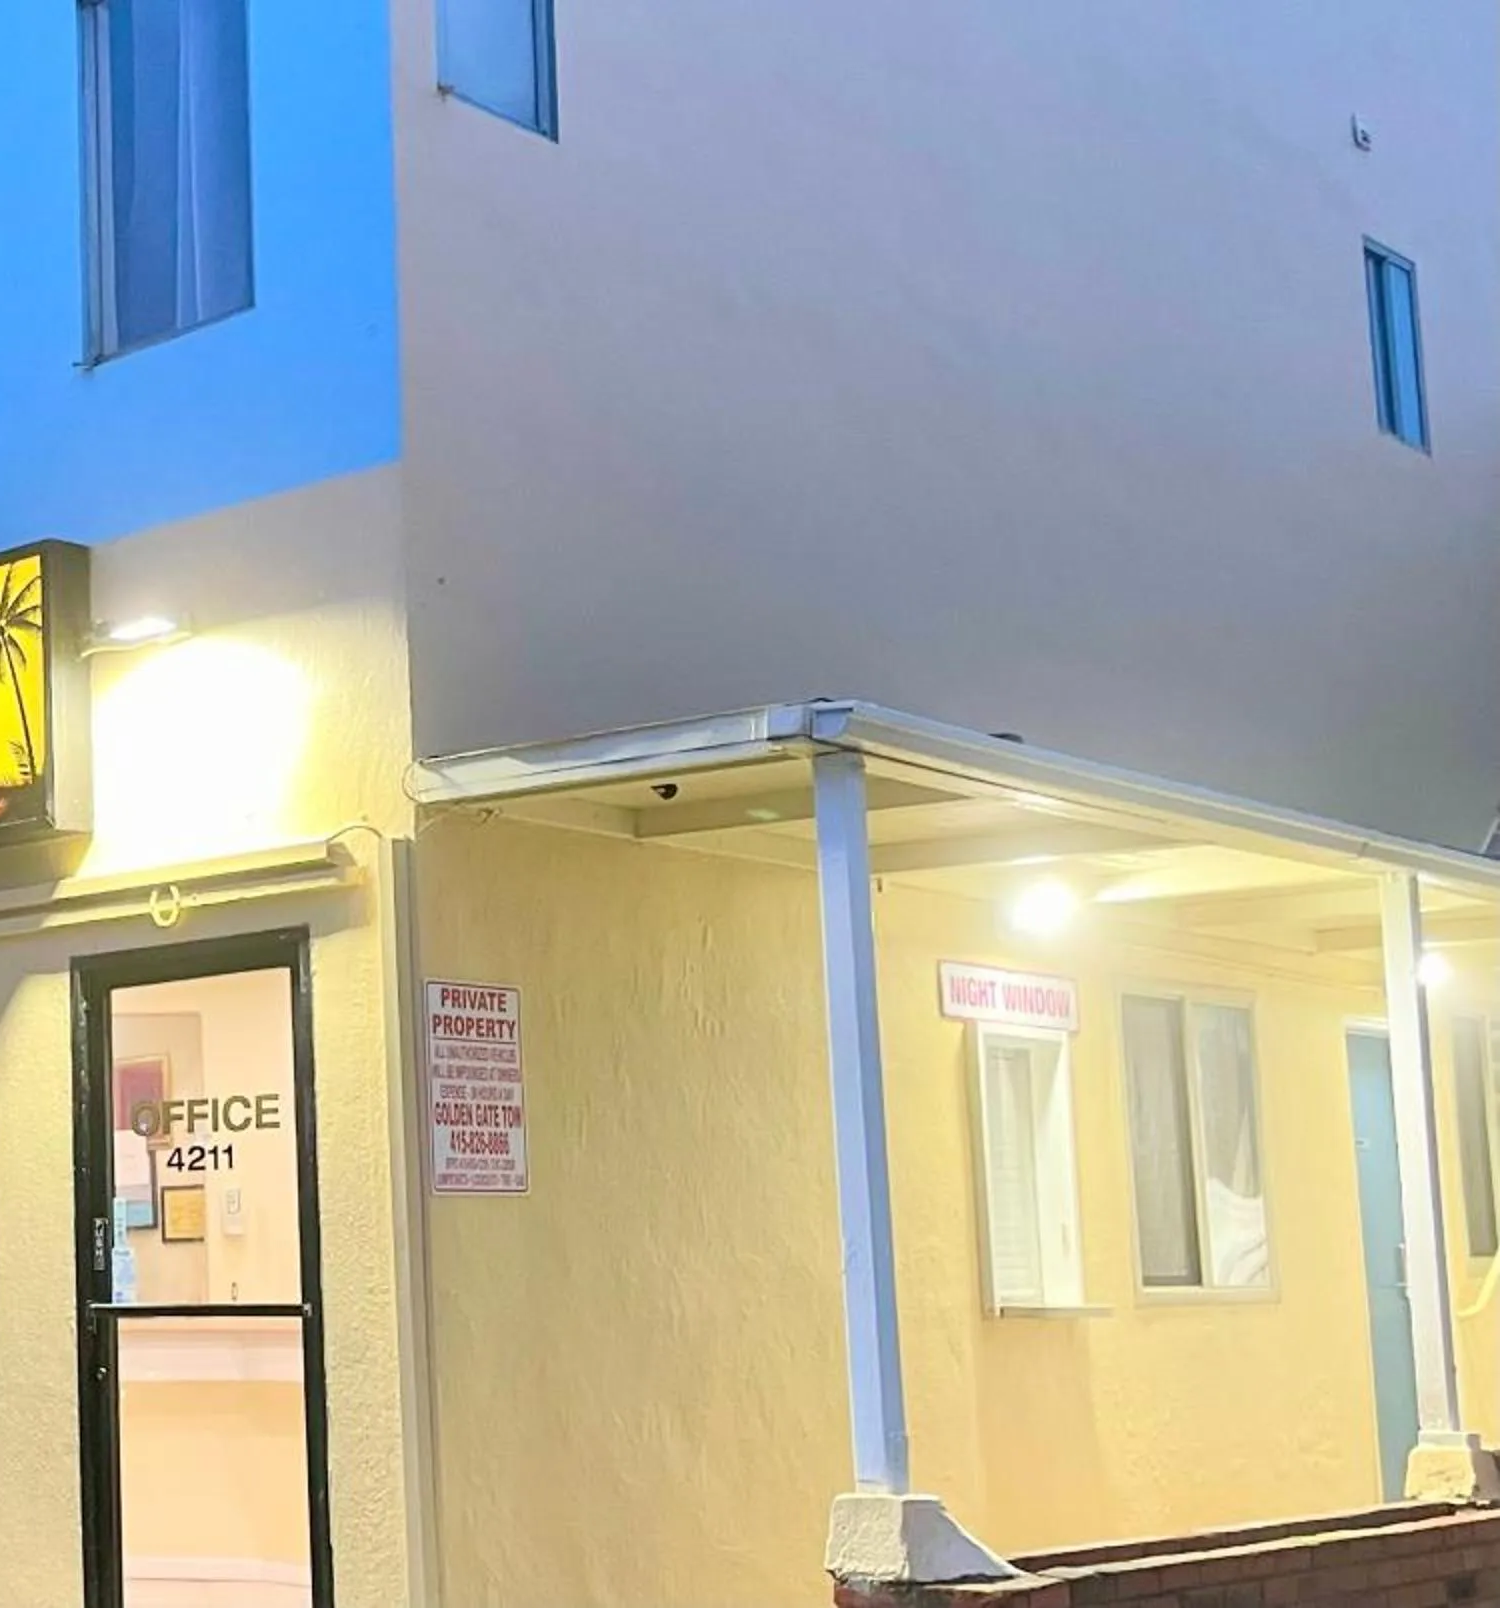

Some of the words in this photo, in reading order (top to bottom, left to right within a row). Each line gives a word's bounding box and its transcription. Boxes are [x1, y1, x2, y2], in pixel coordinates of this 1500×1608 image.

[441, 988, 507, 1012] PRIVATE
[950, 976, 996, 1009] NIGHT
[1002, 982, 1070, 1018] WINDOW
[432, 1014, 516, 1039] PROPERTY
[132, 1094, 280, 1136] OFFICE
[435, 1102, 473, 1127] GOLDEN
[476, 1103, 500, 1129] GATE
[167, 1144, 233, 1172] 4211
